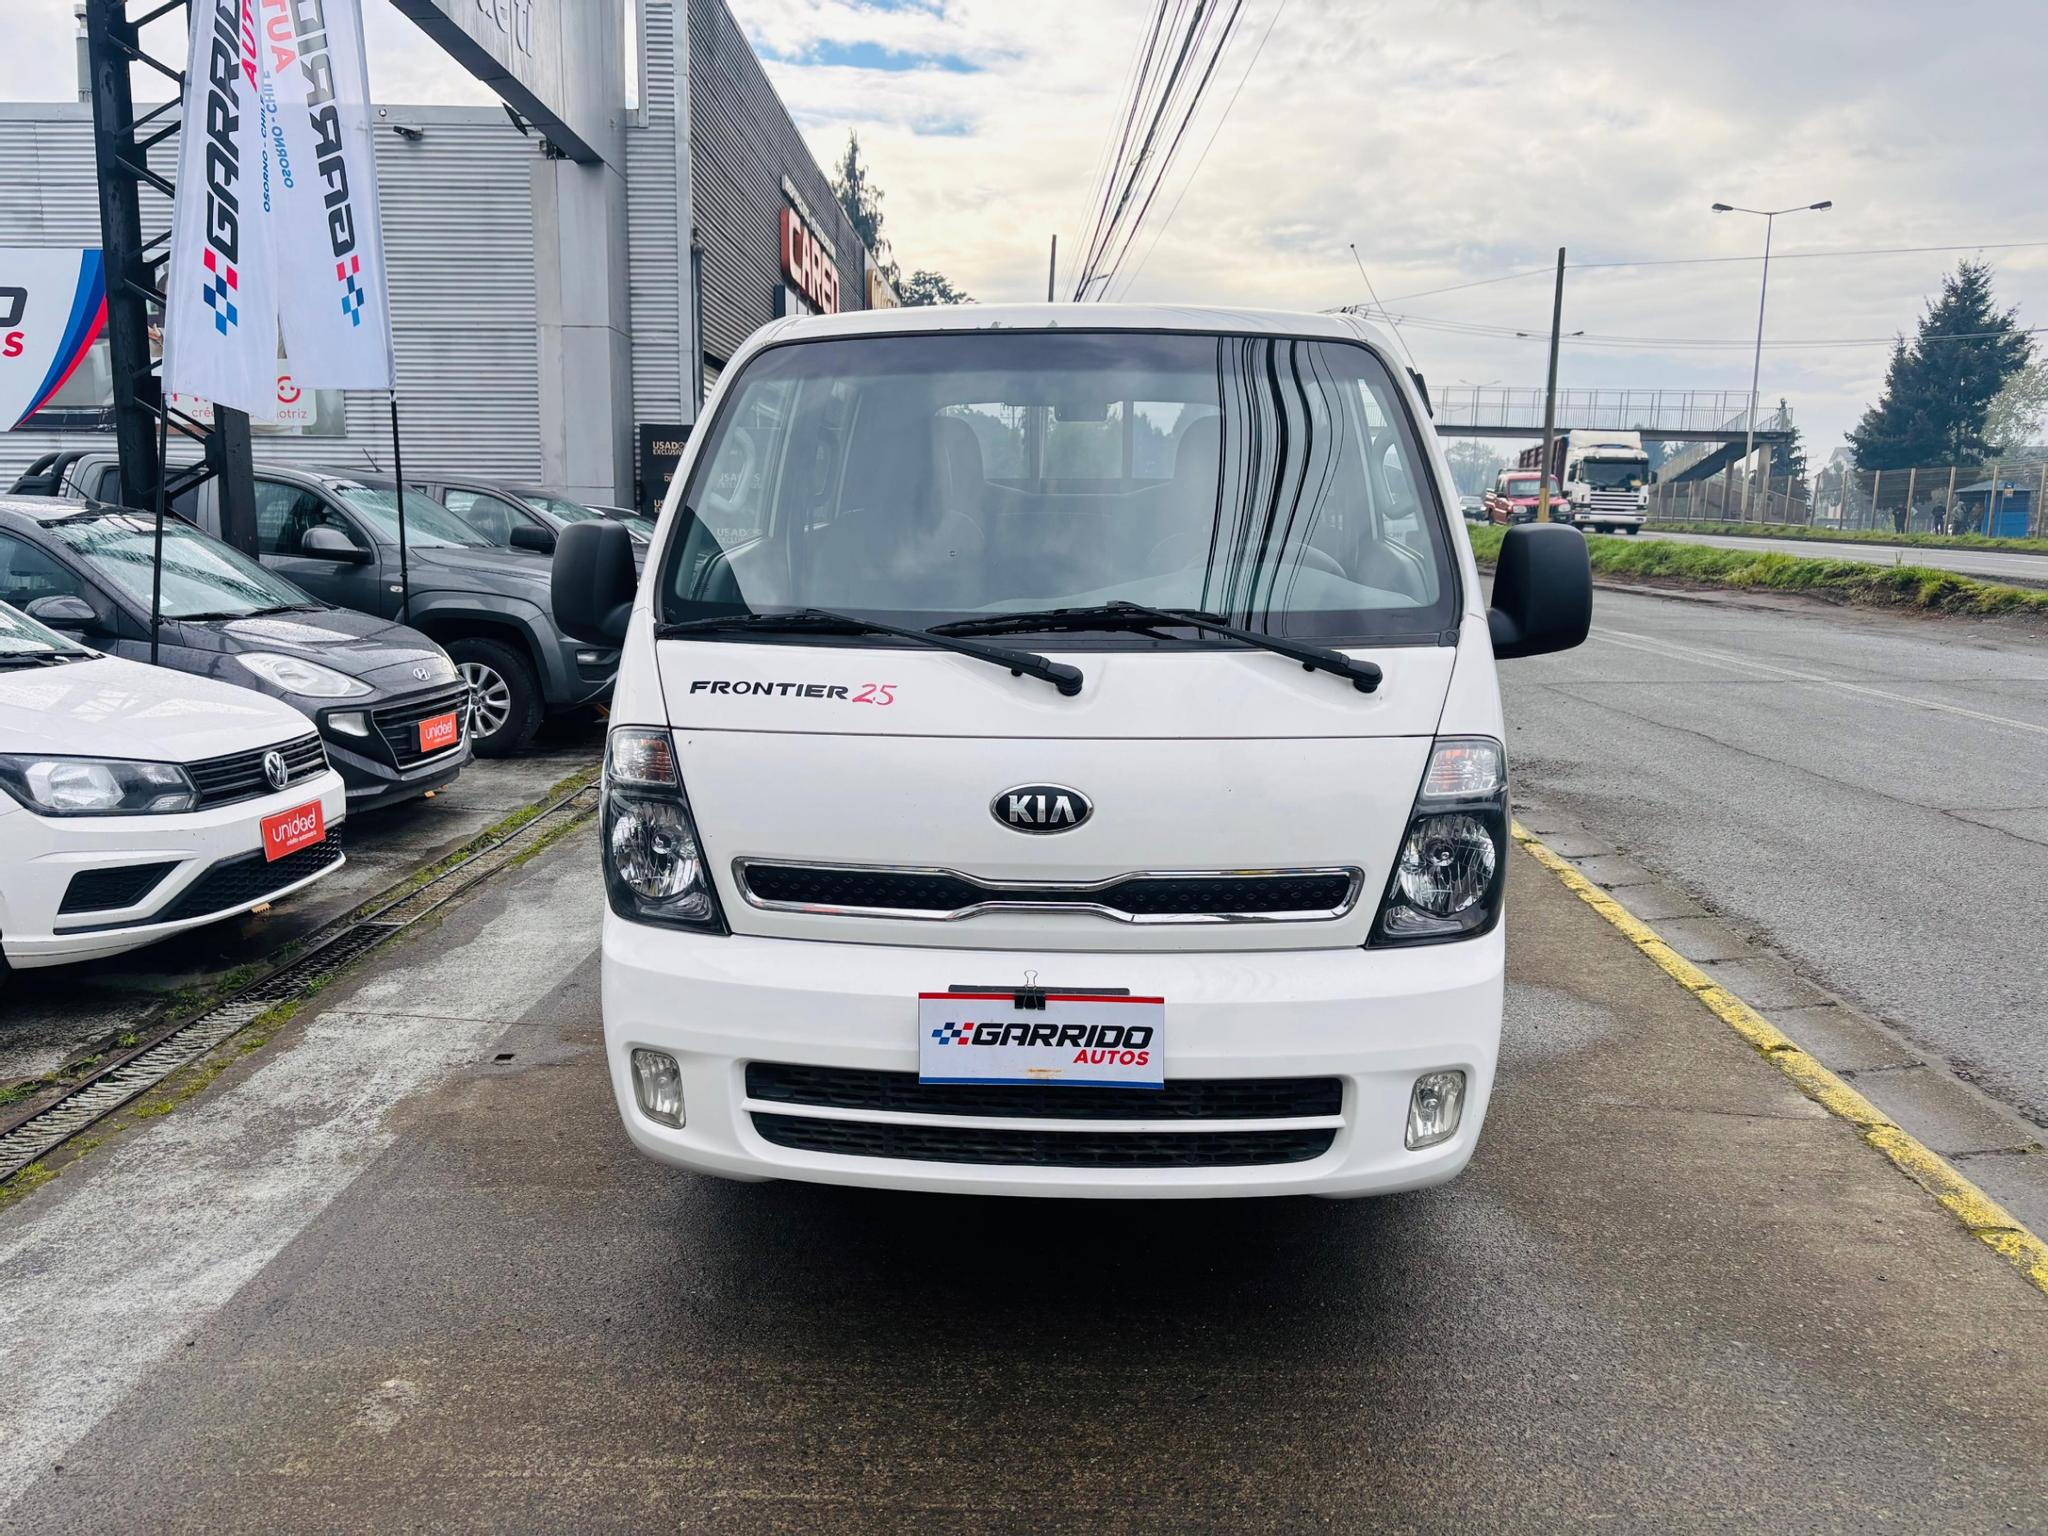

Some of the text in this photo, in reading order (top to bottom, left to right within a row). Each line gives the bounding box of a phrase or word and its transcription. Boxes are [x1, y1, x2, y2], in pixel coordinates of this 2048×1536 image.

[261, 150, 271, 213] OSORNO
[276, 407, 308, 418] otriz
[689, 680, 849, 700] FRONTIER
[425, 718, 453, 740] unidad
[1008, 794, 1076, 823] KIA
[272, 807, 316, 843] unidad
[971, 1022, 1154, 1050] GARRIDO
[1072, 1049, 1150, 1066] AUTOS
